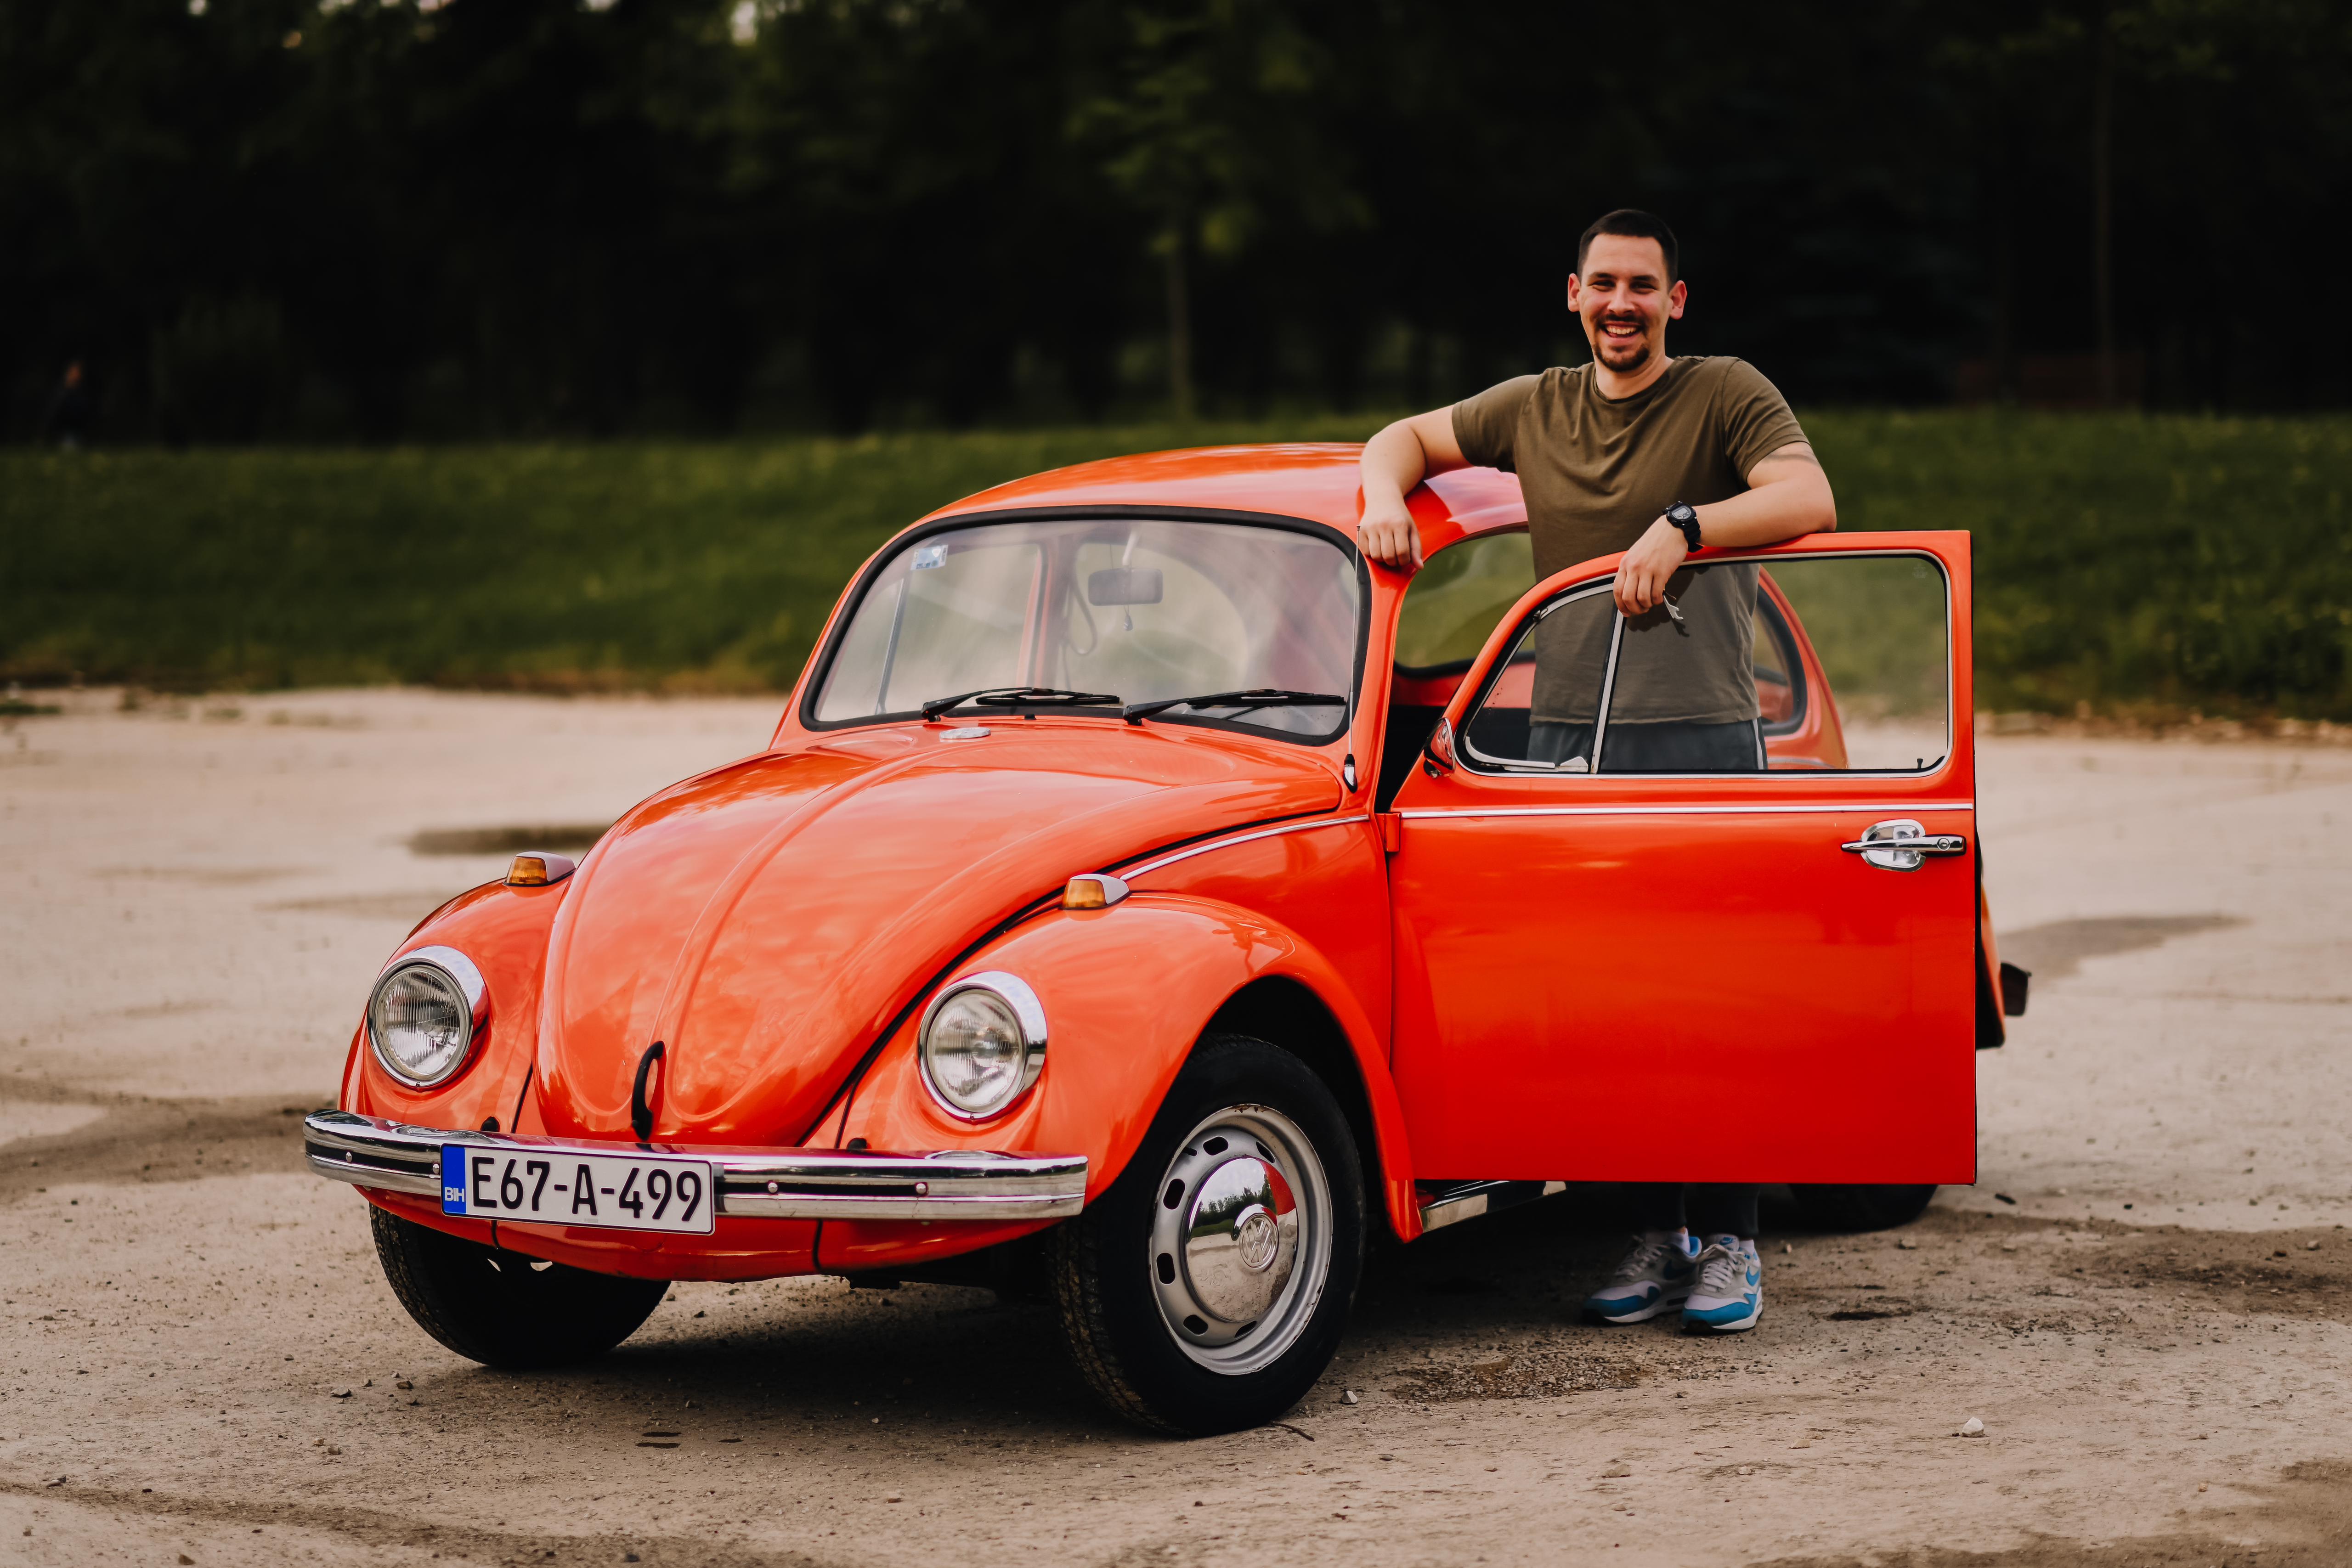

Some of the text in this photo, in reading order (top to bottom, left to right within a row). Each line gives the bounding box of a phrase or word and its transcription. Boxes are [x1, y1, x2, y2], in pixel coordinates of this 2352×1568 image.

[445, 1187, 464, 1202] BIH
[472, 1156, 701, 1222] E67-A-499
[1241, 1215, 1276, 1266] VW
